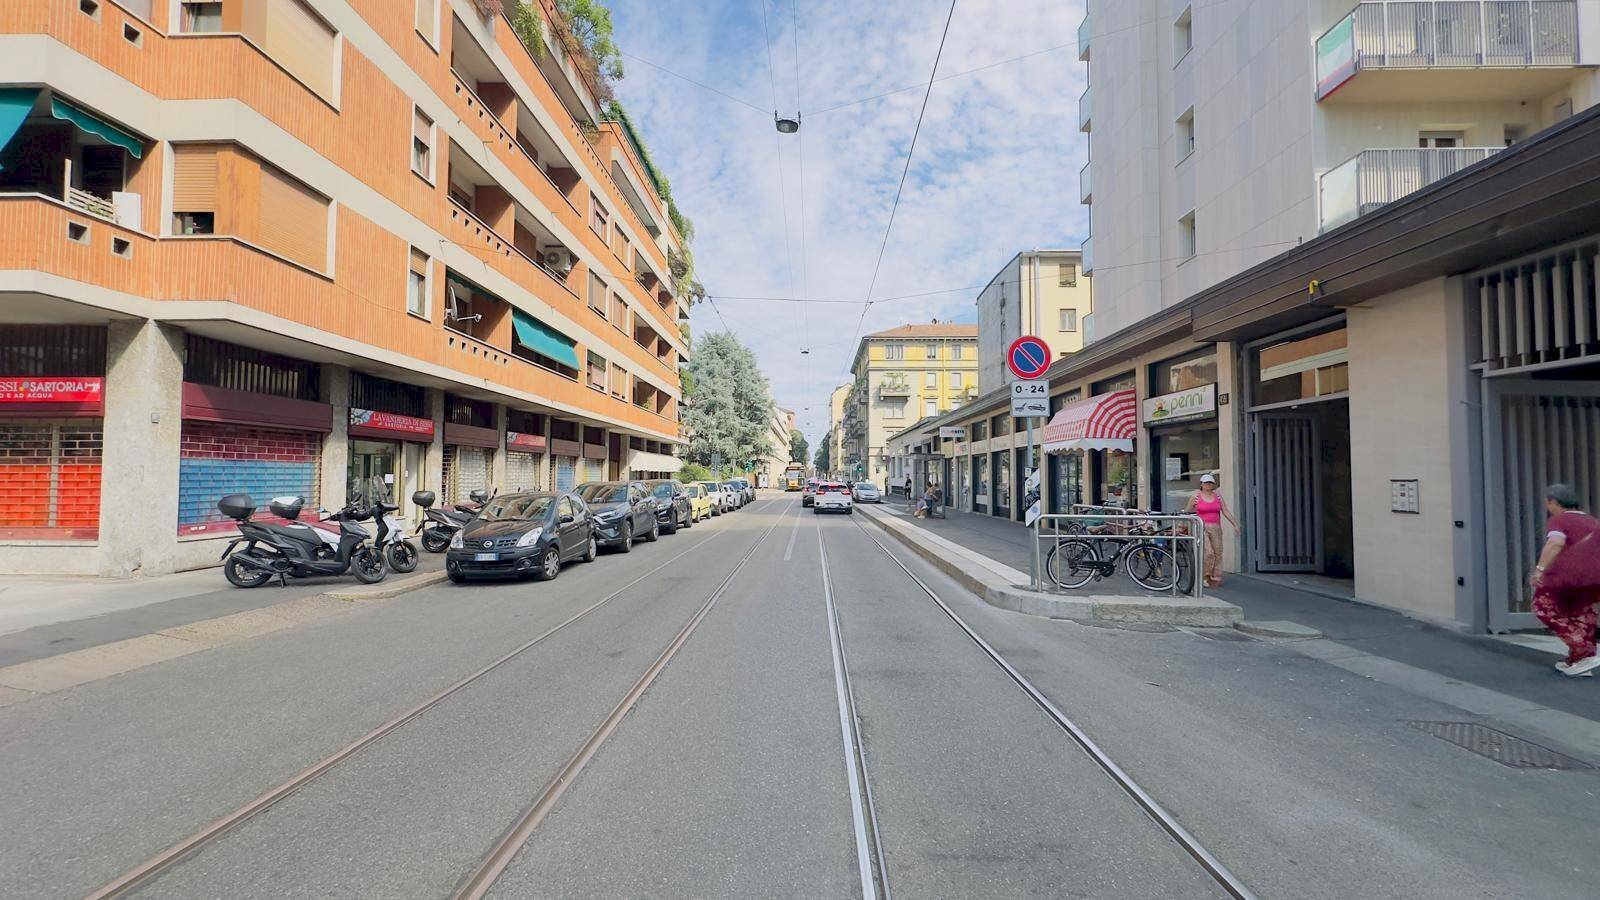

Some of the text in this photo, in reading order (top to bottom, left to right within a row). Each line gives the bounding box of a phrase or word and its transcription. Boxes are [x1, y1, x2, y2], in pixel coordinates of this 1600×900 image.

[30, 381, 84, 392] SARTORIA
[1171, 391, 1203, 415] penni
[373, 413, 412, 425] LAVANDERIA
